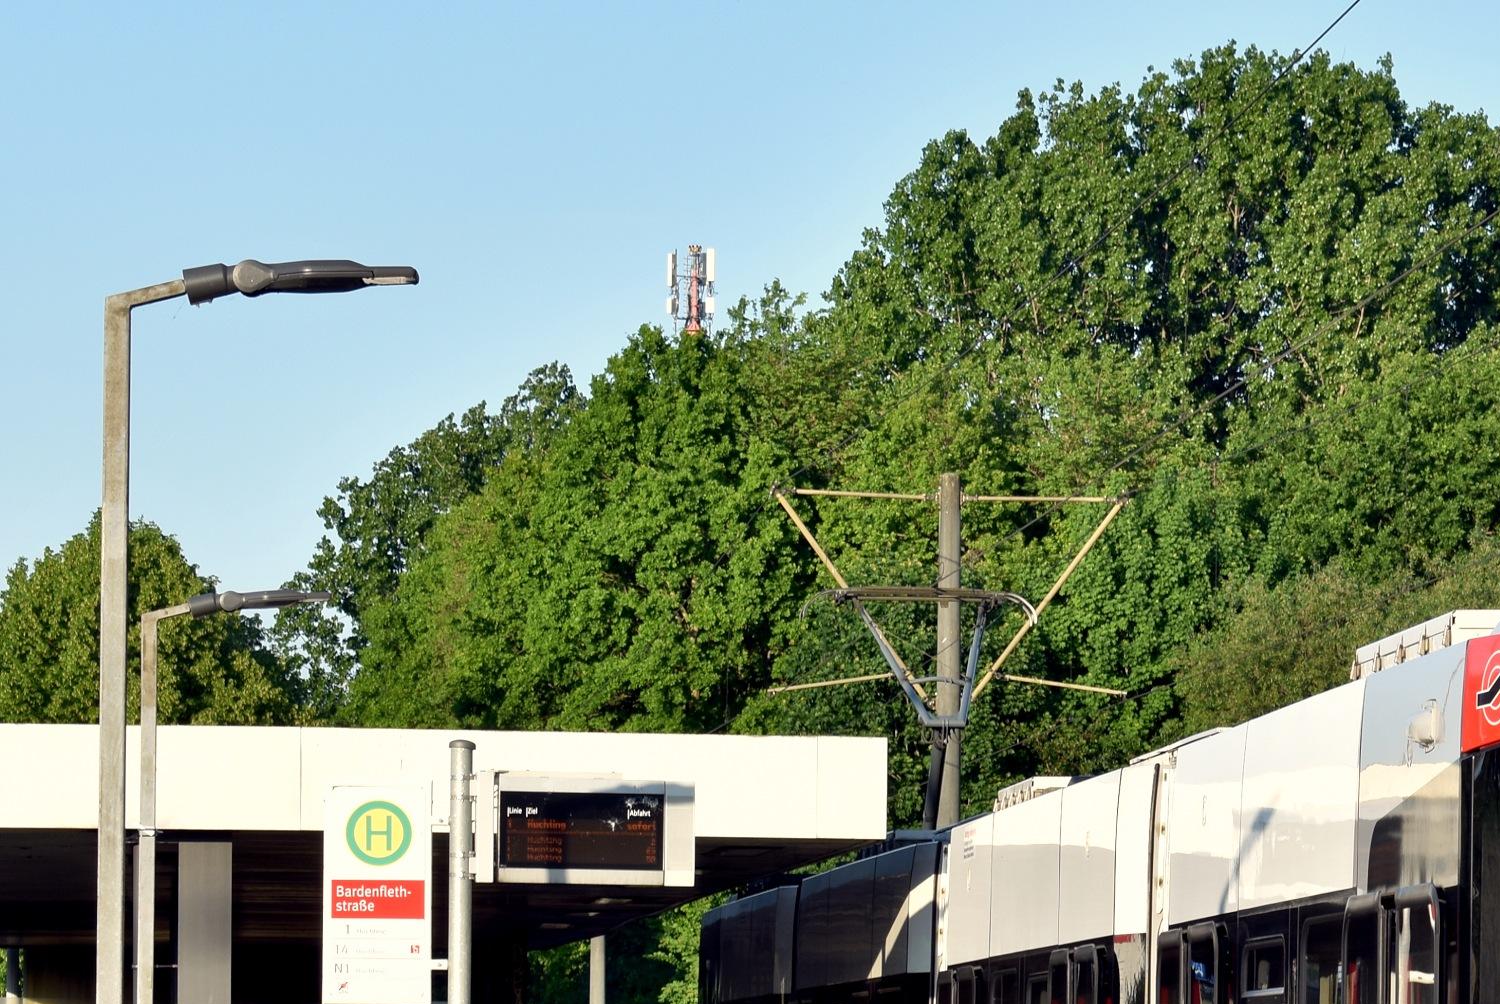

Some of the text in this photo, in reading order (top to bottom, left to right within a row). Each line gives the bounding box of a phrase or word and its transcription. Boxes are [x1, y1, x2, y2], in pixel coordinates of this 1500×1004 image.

[366, 815, 392, 851] H
[336, 885, 411, 898] Bardenfleth-
[336, 900, 375, 912] straße
